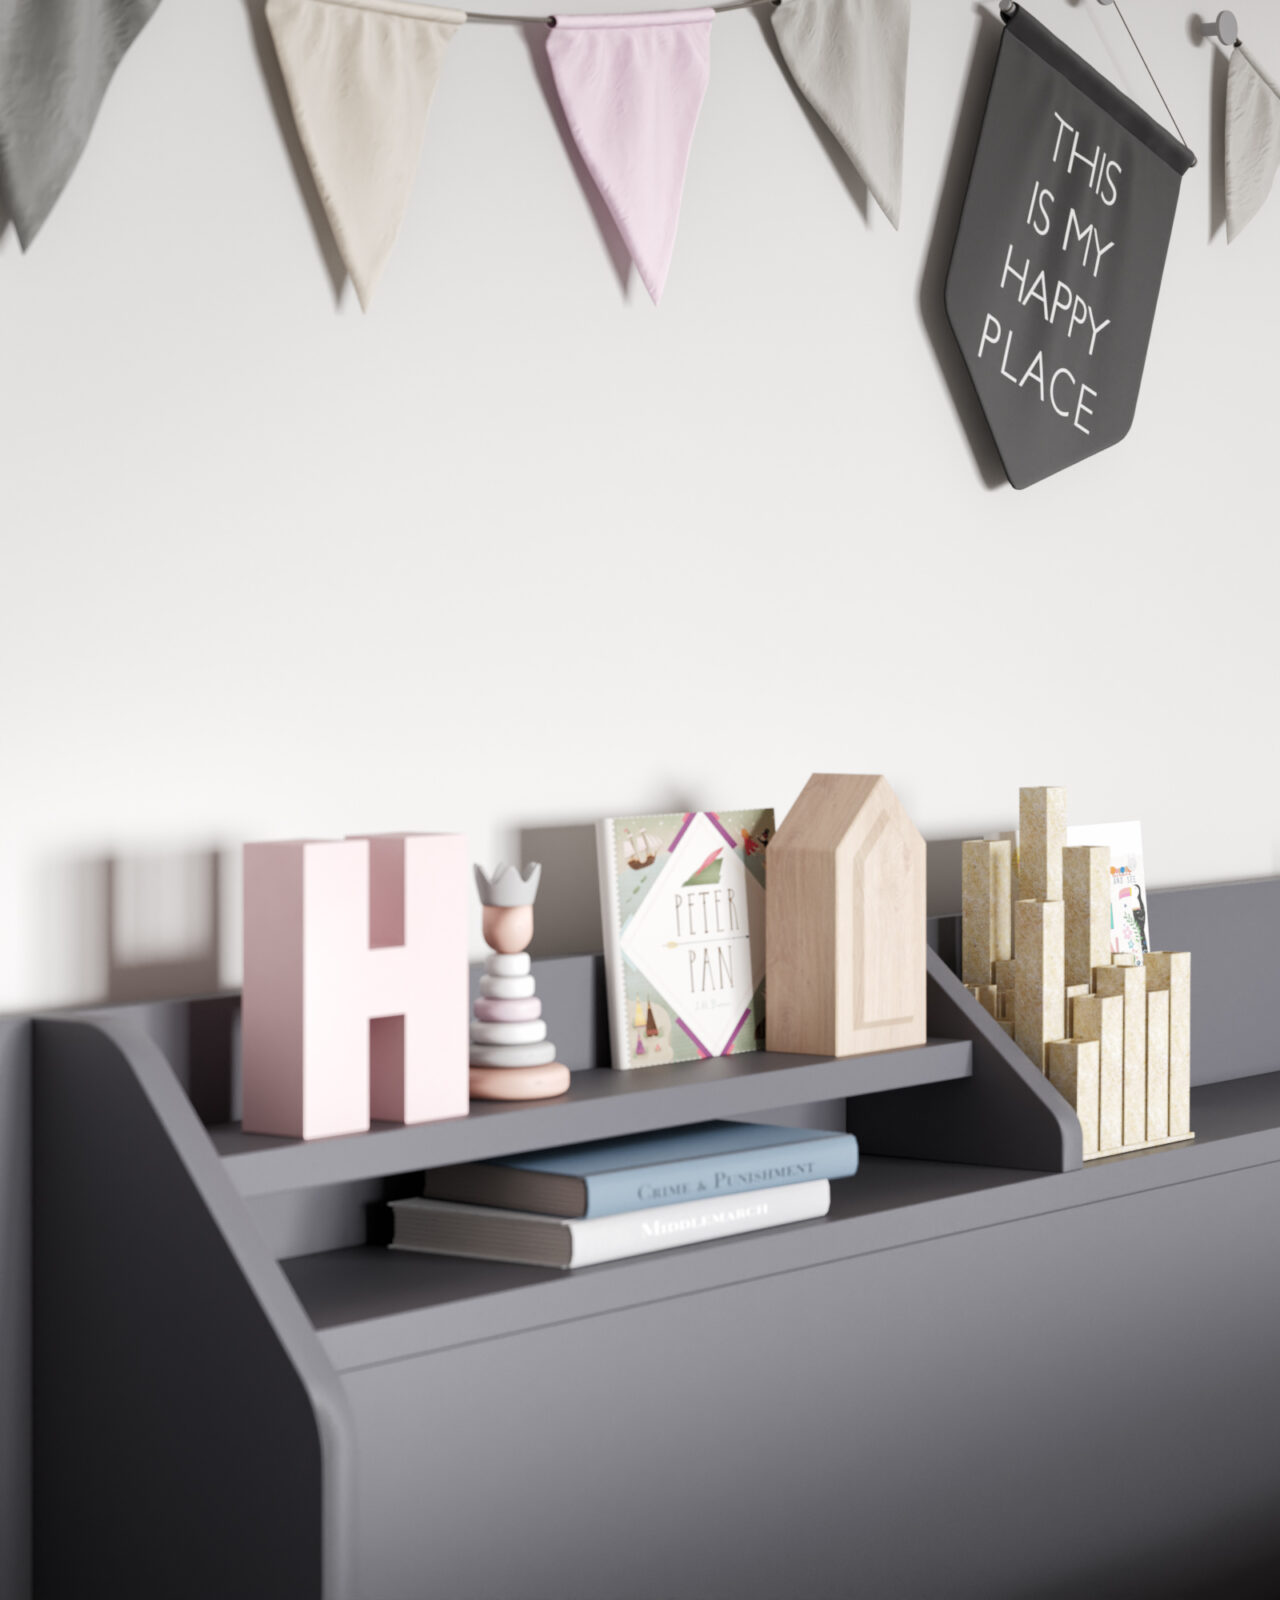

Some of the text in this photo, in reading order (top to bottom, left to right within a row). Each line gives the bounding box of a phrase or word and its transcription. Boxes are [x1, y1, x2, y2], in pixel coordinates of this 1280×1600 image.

[1052, 111, 1122, 207] THIS
[1026, 180, 1115, 278] IS MY
[1000, 243, 1111, 356] HAPPY
[977, 312, 1098, 436] PLACE
[675, 887, 740, 937] PETER
[296, 832, 469, 1142] H
[688, 944, 735, 993] PAN
[696, 1180, 707, 1192] &
